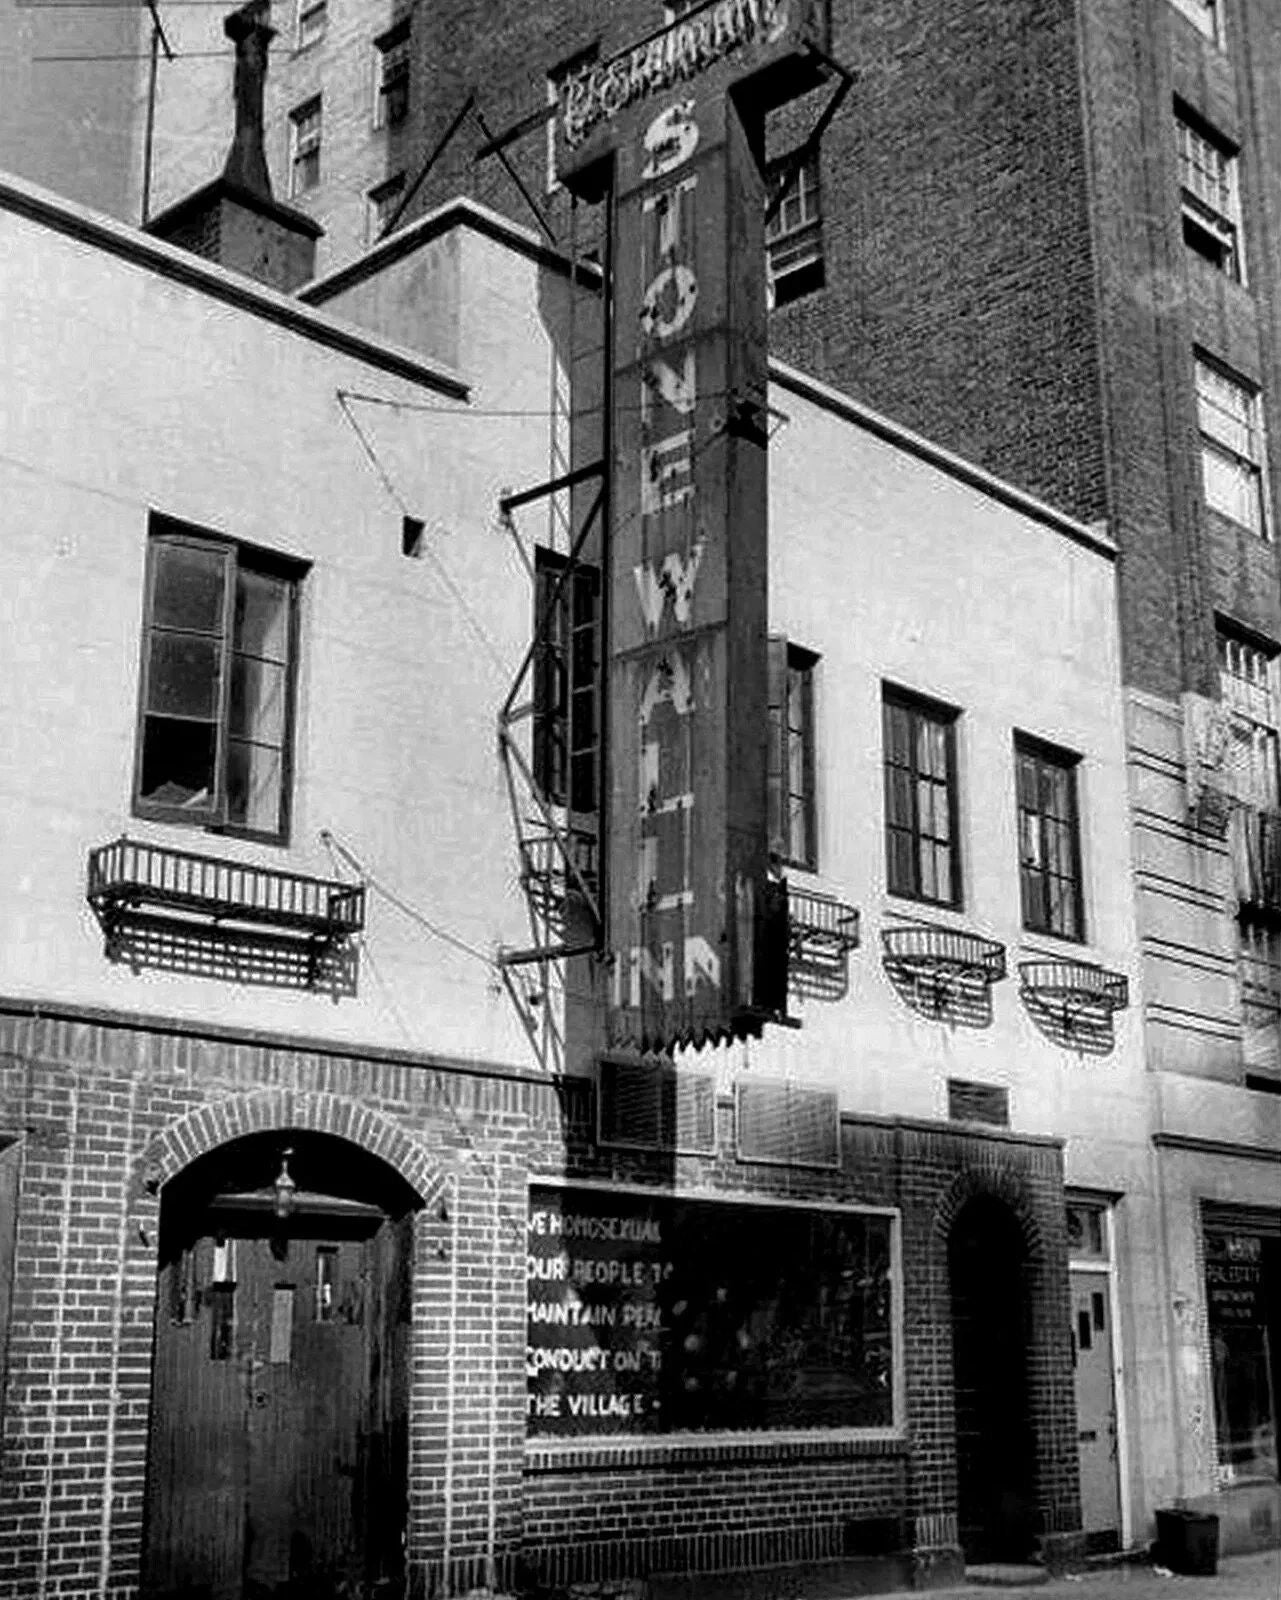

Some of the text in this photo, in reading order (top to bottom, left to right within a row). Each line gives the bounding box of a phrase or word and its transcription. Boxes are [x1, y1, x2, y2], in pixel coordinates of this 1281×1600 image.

[636, 98, 702, 912] STONEWALL
[612, 936, 721, 1008] INN
[526, 1255, 565, 1280] OUR
[573, 1260, 645, 1284] PEOPLE
[525, 1346, 611, 1373] CONDUCT
[613, 1349, 641, 1372] ON
[568, 1394, 643, 1416] VILLAGE
